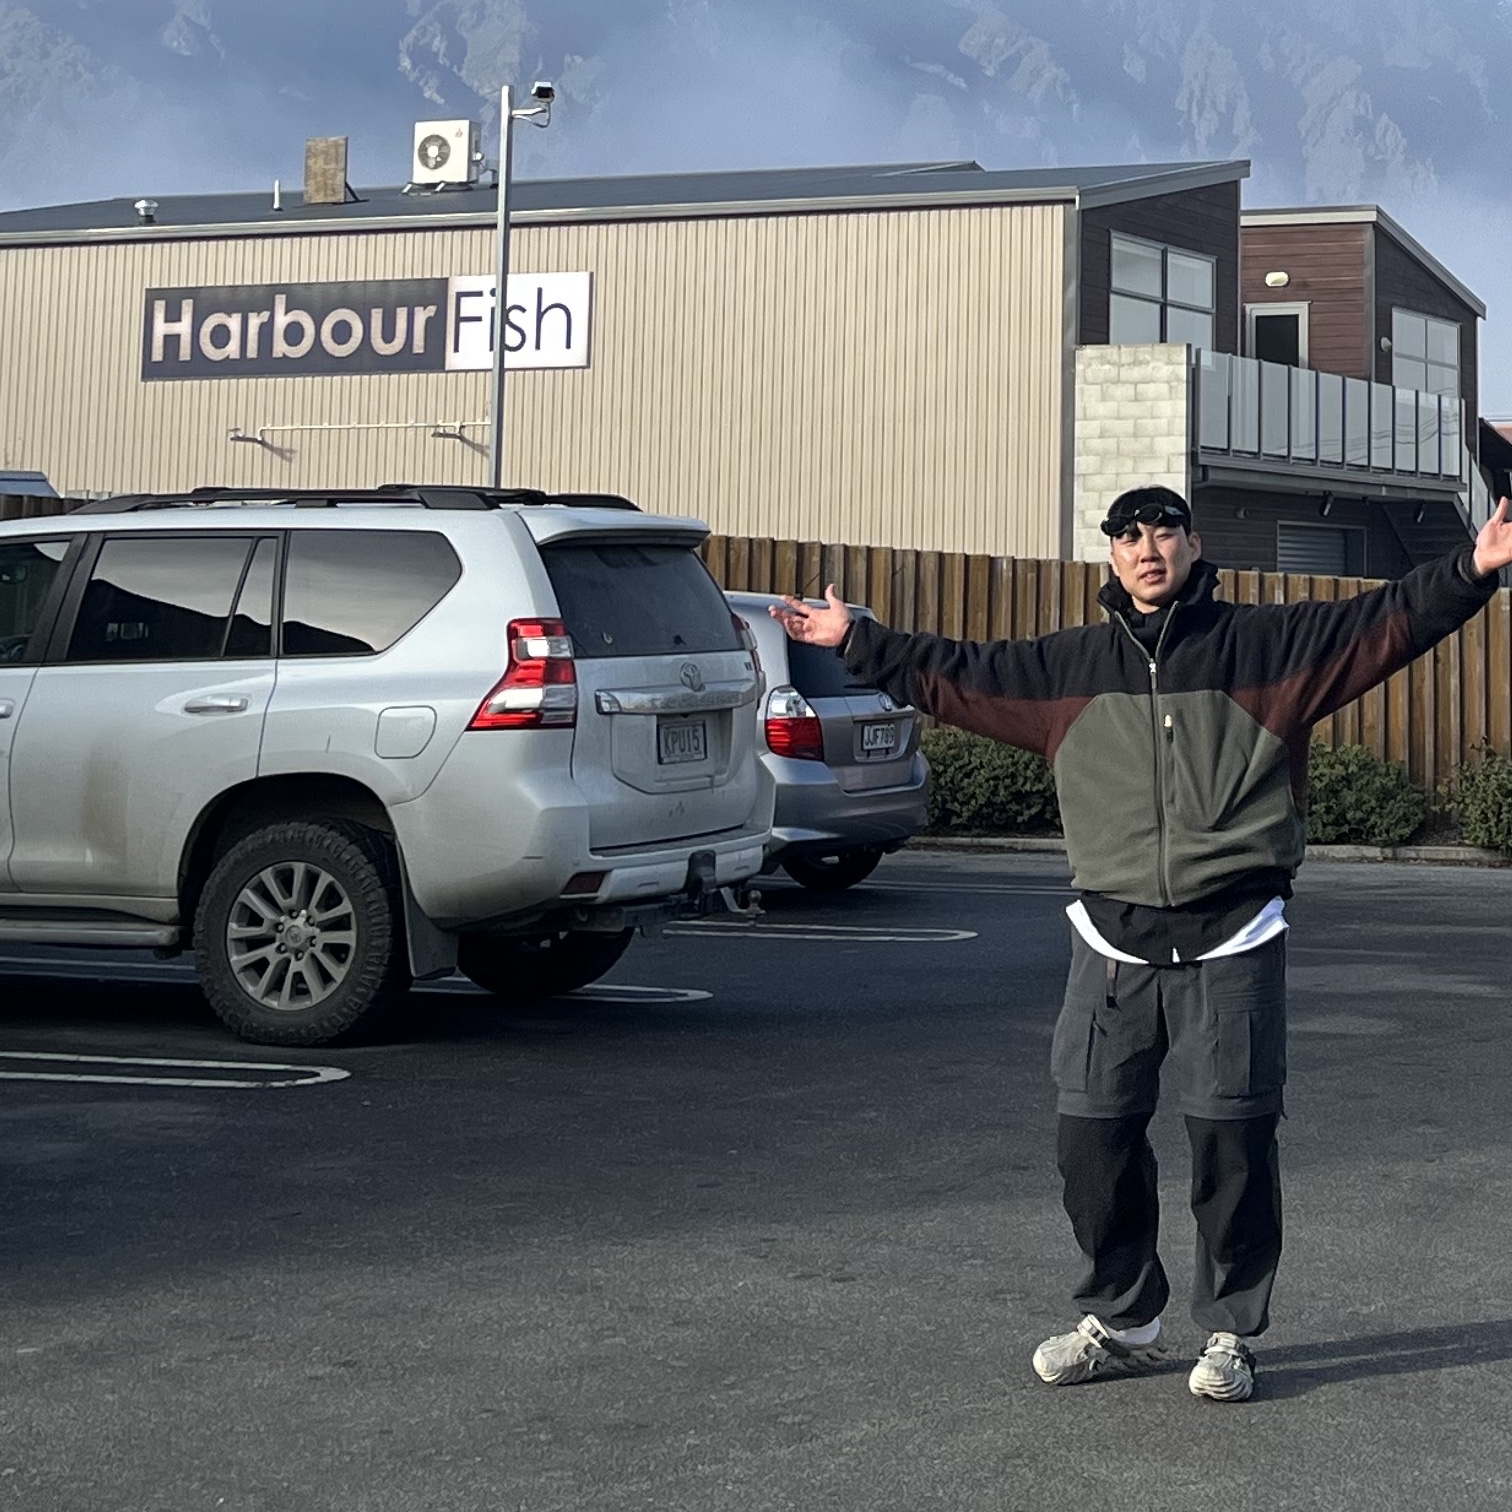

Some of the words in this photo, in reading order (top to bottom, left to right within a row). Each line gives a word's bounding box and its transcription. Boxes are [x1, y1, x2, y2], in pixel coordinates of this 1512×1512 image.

[150, 294, 438, 363] Harbour
[453, 286, 573, 354] Fish
[663, 727, 700, 754] KPU15
